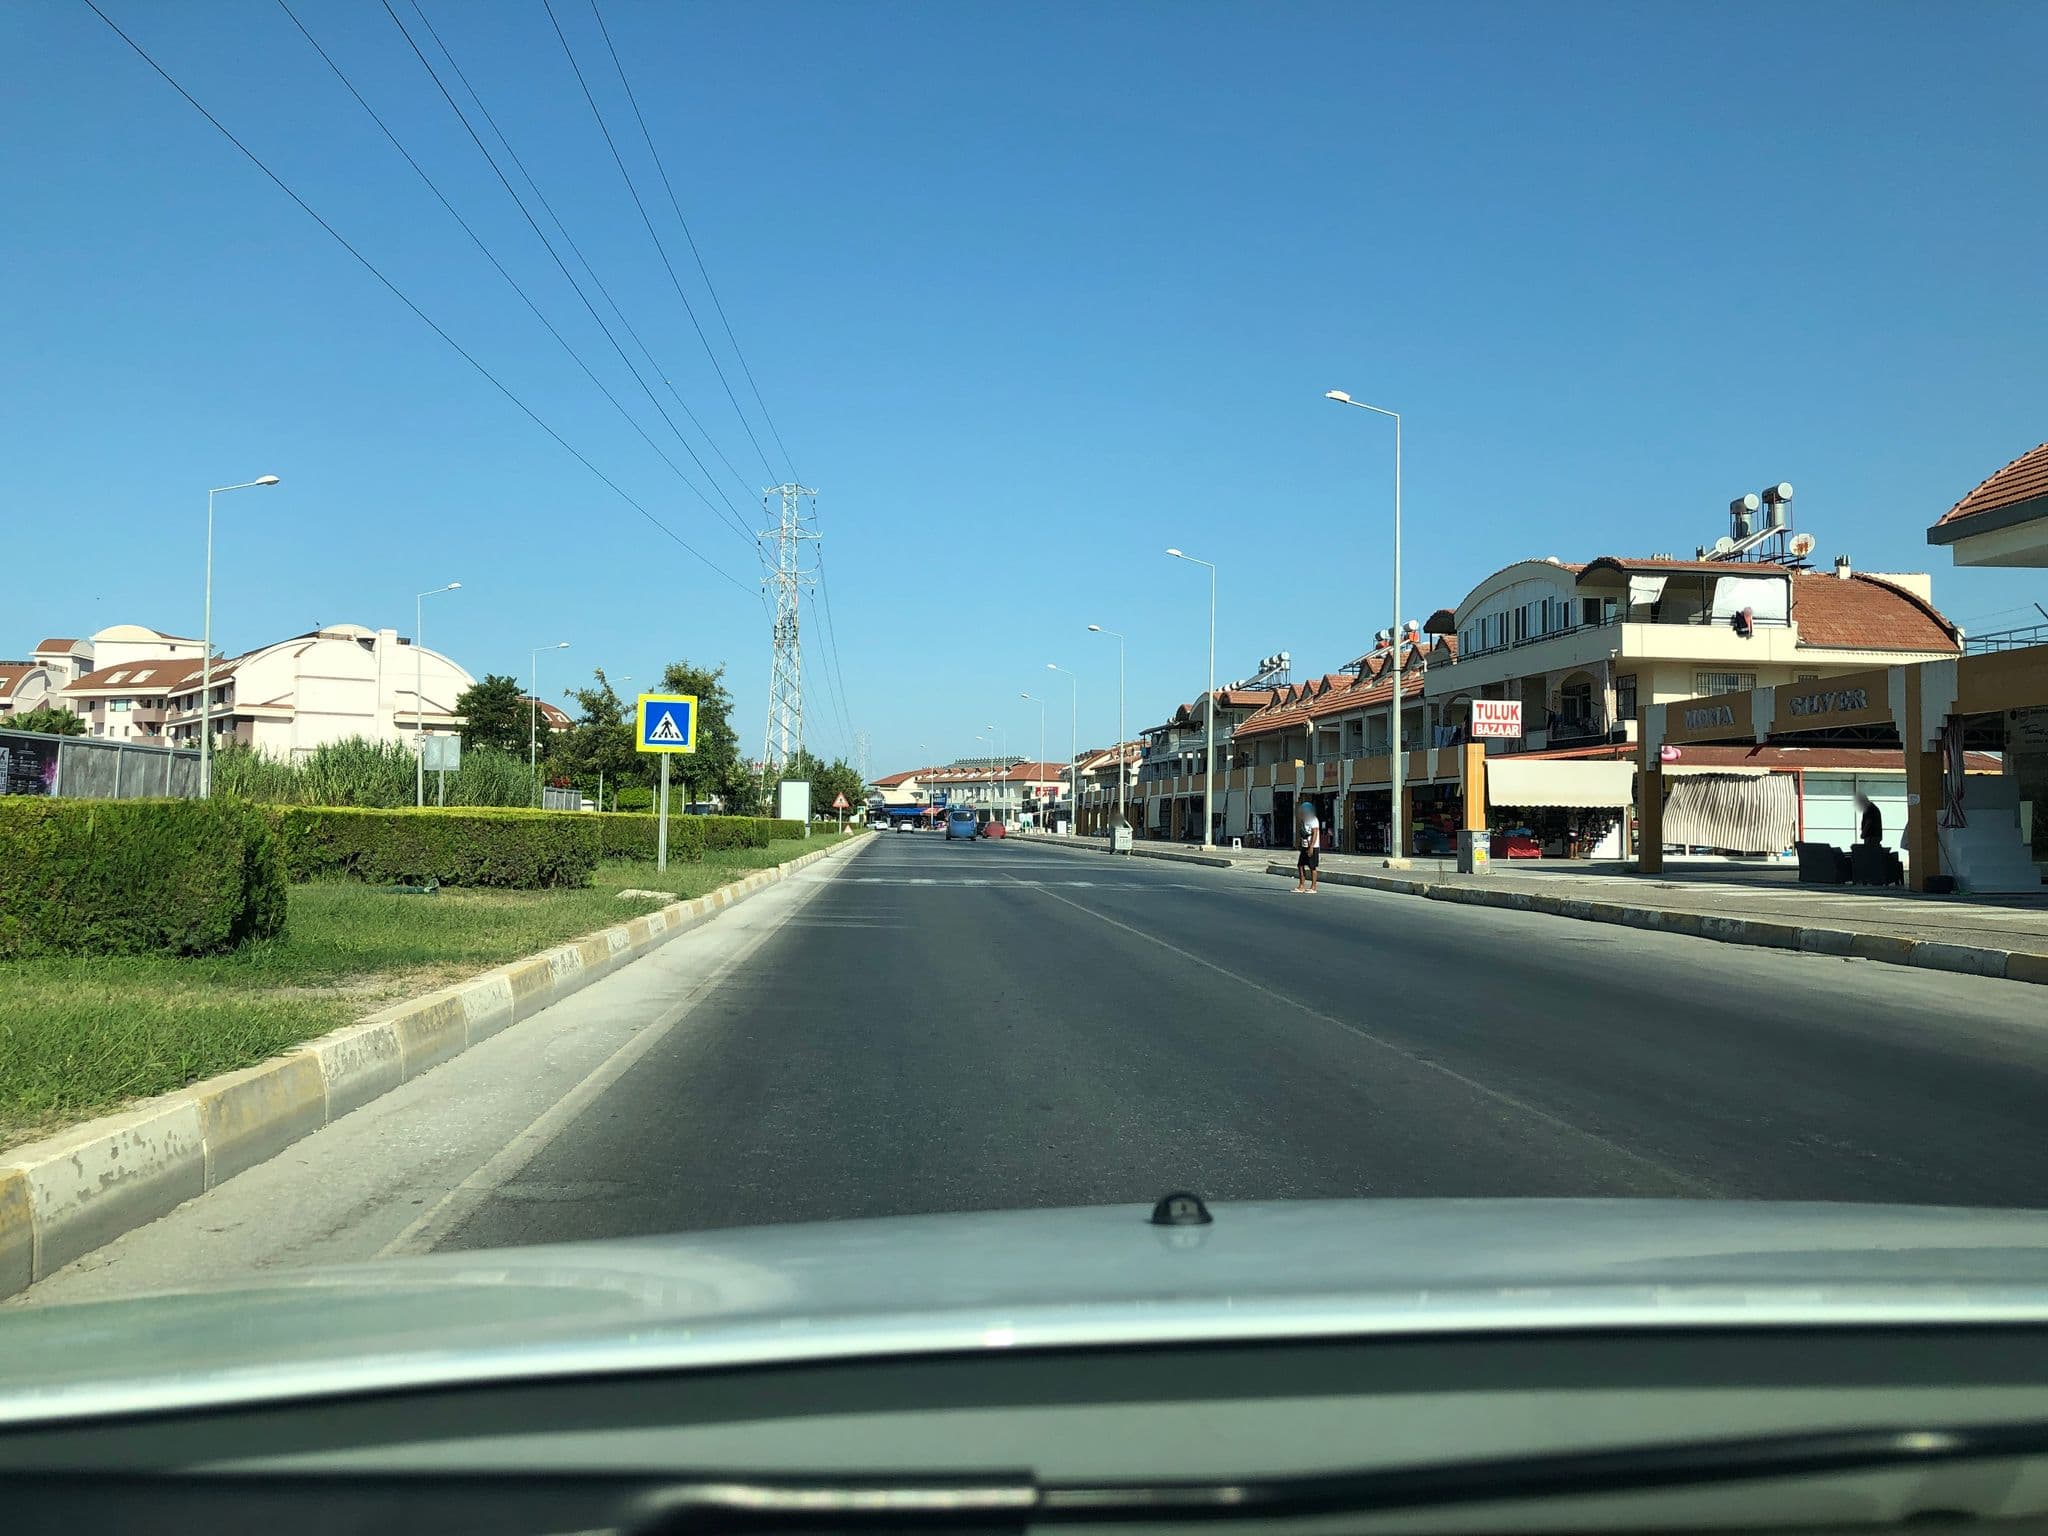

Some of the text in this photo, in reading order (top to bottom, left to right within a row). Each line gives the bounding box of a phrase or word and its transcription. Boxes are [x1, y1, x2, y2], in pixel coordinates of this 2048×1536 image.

[1789, 688, 1868, 714] SILVER
[1476, 703, 1519, 720] TULUK
[1476, 724, 1519, 736] BAZAAR
